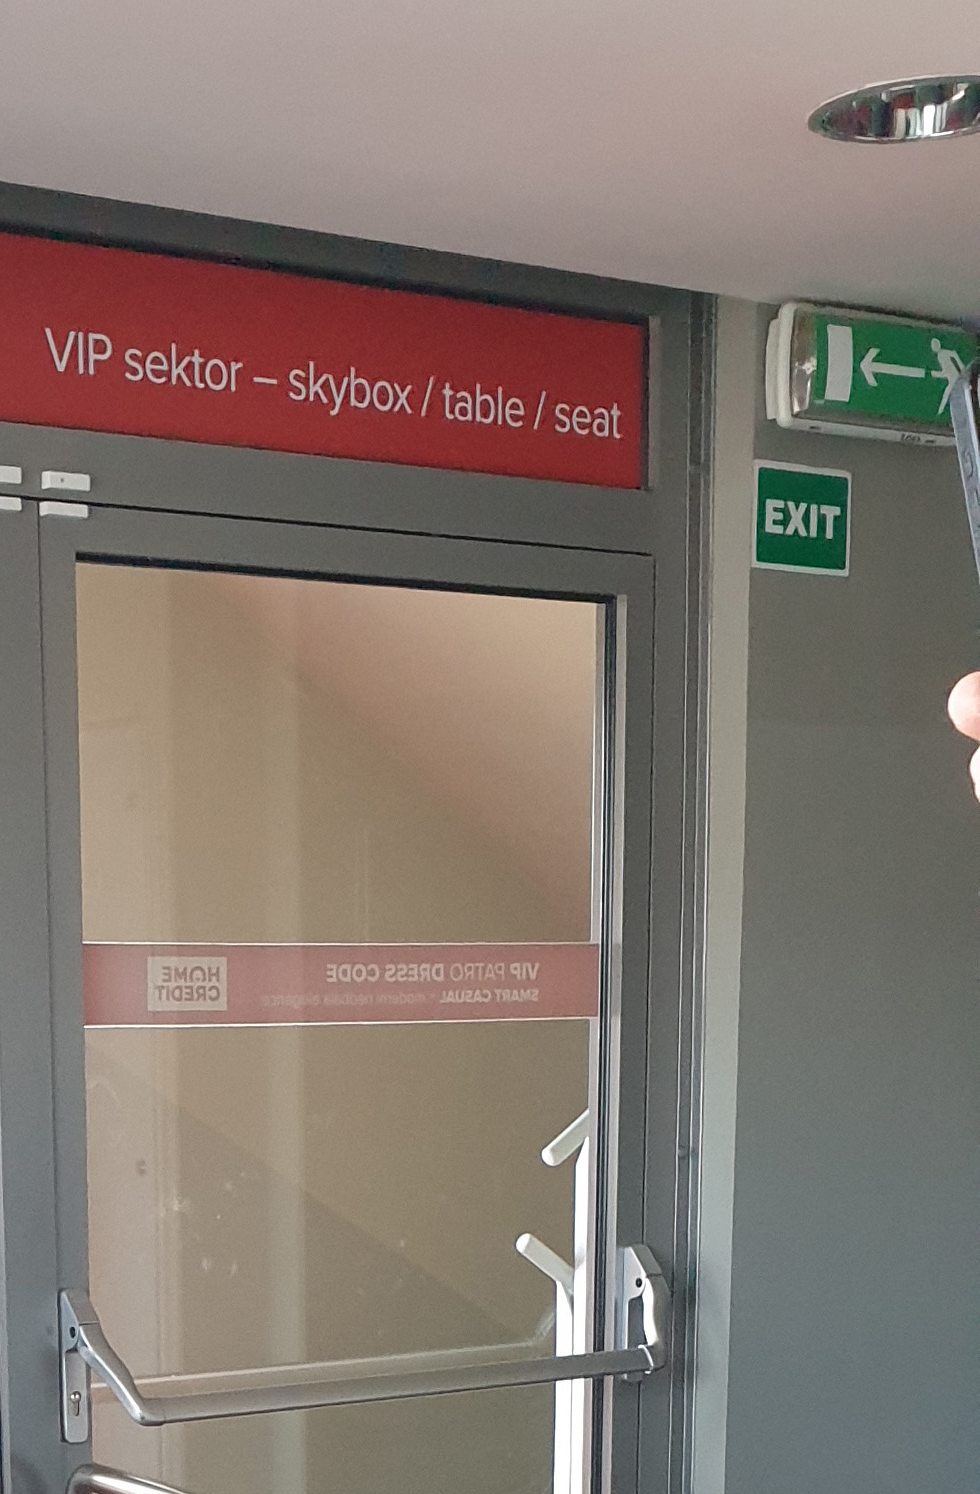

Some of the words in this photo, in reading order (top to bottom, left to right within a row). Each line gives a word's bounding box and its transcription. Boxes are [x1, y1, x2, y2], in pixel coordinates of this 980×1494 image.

[45, 327, 113, 377] VIP
[124, 342, 243, 393] sektor
[288, 361, 412, 417] skybox
[443, 381, 524, 428] table
[555, 400, 622, 439] seat
[765, 498, 841, 540] EXIT
